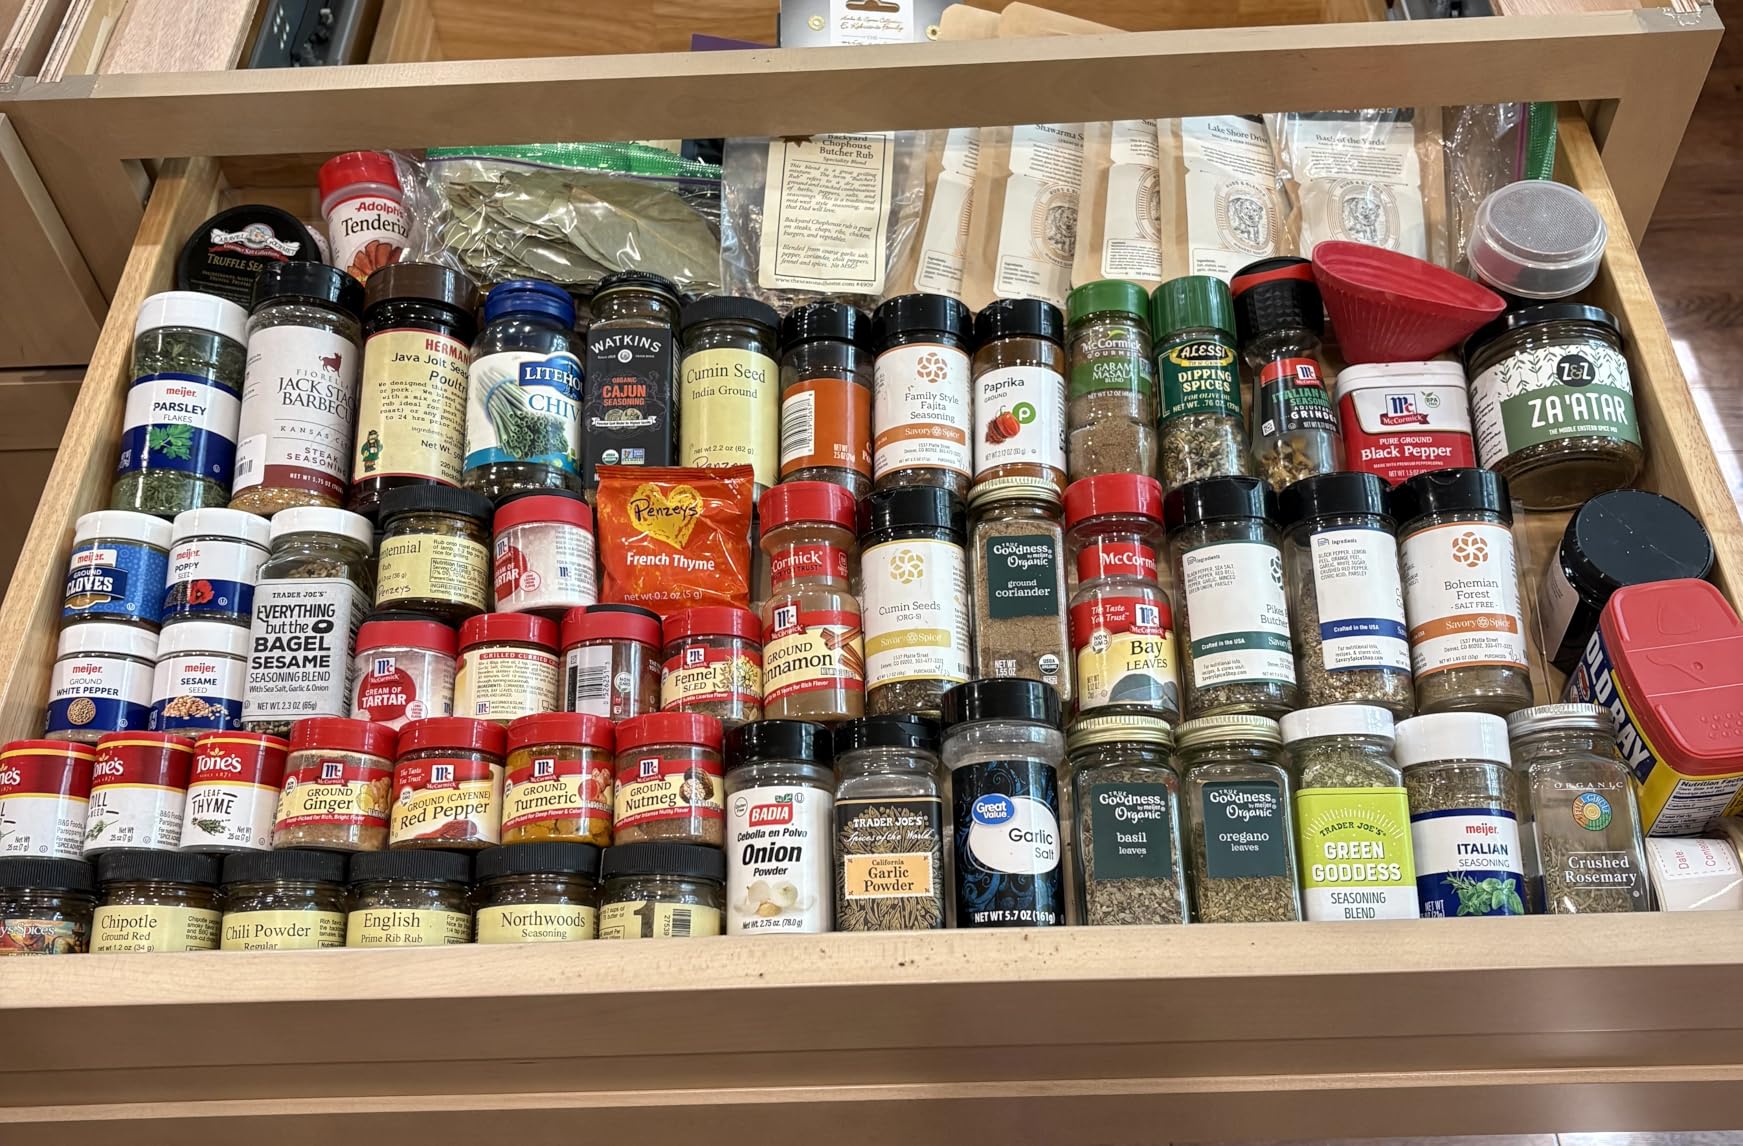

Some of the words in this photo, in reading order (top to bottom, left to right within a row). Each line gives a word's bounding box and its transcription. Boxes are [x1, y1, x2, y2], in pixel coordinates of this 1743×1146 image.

[1208, 123, 1225, 134] Lake
[1226, 128, 1249, 139] Shore
[822, 139, 872, 150] Chophouse
[820, 147, 854, 157] Butcher
[856, 151, 874, 159] Rub
[208, 254, 245, 269] TRUFFLE
[591, 334, 662, 355] WATKINS
[391, 353, 420, 362] Java
[687, 363, 728, 384] Cumin
[734, 363, 766, 384] Seed
[1093, 371, 1133, 380] MASALA
[1178, 371, 1232, 383] DIPPING
[277, 377, 323, 396] JACK
[603, 385, 646, 398] CAJUN
[984, 377, 1025, 394] Paprika
[1183, 381, 1230, 393] SPICES
[692, 386, 715, 400] India
[718, 386, 757, 399] Ground
[905, 393, 938, 402] Family
[939, 393, 959, 405] Style
[604, 398, 644, 406] SEASONING
[921, 401, 946, 411] Fajita
[153, 402, 207, 416] PARSLEY
[163, 414, 193, 423] FLAKES
[910, 411, 955, 423] Seasoning
[1383, 415, 1423, 425] McCormick
[905, 427, 932, 437] Savory
[421, 440, 437, 449] Net
[1379, 437, 1398, 445] PURE
[1400, 436, 1432, 444] GROUND
[305, 447, 339, 463] STEAK
[1362, 446, 1400, 461] Black
[1404, 446, 1452, 457] Pepper
[634, 498, 698, 521] Penzeys
[994, 543, 1049, 556] Goodness
[174, 561, 199, 573] POPPY
[627, 552, 670, 565] French
[673, 554, 715, 570] Thyme
[1007, 556, 1049, 570] Organic
[73, 569, 102, 578] GROUND
[66, 576, 113, 595] CLOVES
[1007, 579, 1037, 588] ground
[1444, 580, 1499, 590] Bohemian
[624, 592, 640, 600] net
[995, 587, 1050, 598] coriander
[1456, 590, 1490, 600] Forest
[879, 603, 910, 615] Cumin
[913, 601, 940, 610] Seeds
[1106, 604, 1125, 613] Taste
[1454, 601, 1476, 610] SALT
[1478, 601, 1495, 609] FREE
[257, 603, 335, 622] EVERYTHING
[1446, 618, 1477, 629] Savory
[254, 636, 331, 652] BAGEL
[1131, 639, 1163, 655] Bay
[767, 642, 812, 664] GROUND
[251, 655, 330, 669] SESAME
[995, 660, 1006, 668] NET
[1126, 658, 1167, 671] LEAVES
[180, 677, 217, 685] SESAME
[250, 671, 300, 683] SEASONING
[302, 671, 330, 682] BLEND
[675, 669, 716, 684] Fennel
[56, 687, 82, 696] WHITE
[83, 687, 118, 696] PEPPER
[188, 686, 207, 694] SEED
[249, 684, 263, 693] With
[264, 684, 275, 692] Sea
[312, 684, 328, 692] Onion
[365, 688, 387, 696] CREAM
[683, 682, 706, 693] SEED
[257, 702, 272, 710] NET
[362, 693, 407, 708] TARTAR
[523, 783, 567, 796] GROUND
[630, 782, 672, 797] GROUND
[1554, 781, 1624, 790] ORGANIC
[203, 789, 221, 797] LEAF
[307, 788, 353, 797] GROUND
[1100, 792, 1161, 805] Goodness
[1210, 791, 1271, 804] Goodness
[192, 799, 235, 815] THYME
[304, 799, 353, 813] Ginger
[408, 796, 444, 813] GROUND
[447, 790, 491, 805] (CAYENNE)
[514, 793, 577, 812] Turmeric
[625, 792, 677, 812] Nutmeg
[976, 801, 1007, 813] Great
[400, 812, 432, 830] Red
[433, 801, 490, 821] Pepper
[751, 806, 789, 822] BADIA
[984, 811, 1007, 819] Value
[1115, 807, 1161, 824] Organic
[1227, 804, 1272, 822] Organic
[853, 817, 892, 828] TRADER
[896, 816, 923, 826] JOE'S
[737, 831, 766, 842] Cebolla
[768, 830, 780, 838] en
[782, 828, 807, 838] Polvo
[1009, 828, 1053, 844] Garlic
[1320, 822, 1355, 837] TRADER
[1117, 832, 1147, 843] basil
[1219, 832, 1269, 843] oregano
[1119, 846, 1147, 855] leaves
[1231, 843, 1259, 852] leaves
[1324, 842, 1385, 860] GREEN
[1457, 843, 1508, 856] ITALIAN
[742, 844, 802, 866] Onion
[1035, 848, 1054, 861] Salt
[1459, 857, 1510, 868] SEASONING
[1568, 856, 1630, 870] Crushed
[753, 867, 788, 877] Powder
[868, 867, 909, 879] Garlic
[1312, 863, 1402, 882] GODDESS
[1565, 870, 1637, 887] Rosemary
[864, 879, 914, 892] Powder
[1331, 892, 1386, 904] SEASONING
[975, 912, 988, 923] NET
[990, 911, 1003, 921] WT
[1005, 910, 1018, 920] 5.7
[1020, 910, 1032, 920] OZ
[1344, 907, 1375, 919] BLEND
[101, 915, 158, 931] Chipotle
[364, 913, 420, 931] English
[501, 912, 586, 928] Northwoods
[743, 921, 751, 929] Net
[101, 932, 129, 941] Ground
[132, 932, 151, 940] Red
[225, 925, 250, 941] Chili
[254, 923, 311, 939] Powder
[361, 935, 383, 943] Prime
[385, 934, 401, 943] Rib
[405, 934, 423, 943] Rub
[521, 929, 568, 939] Seasoning
